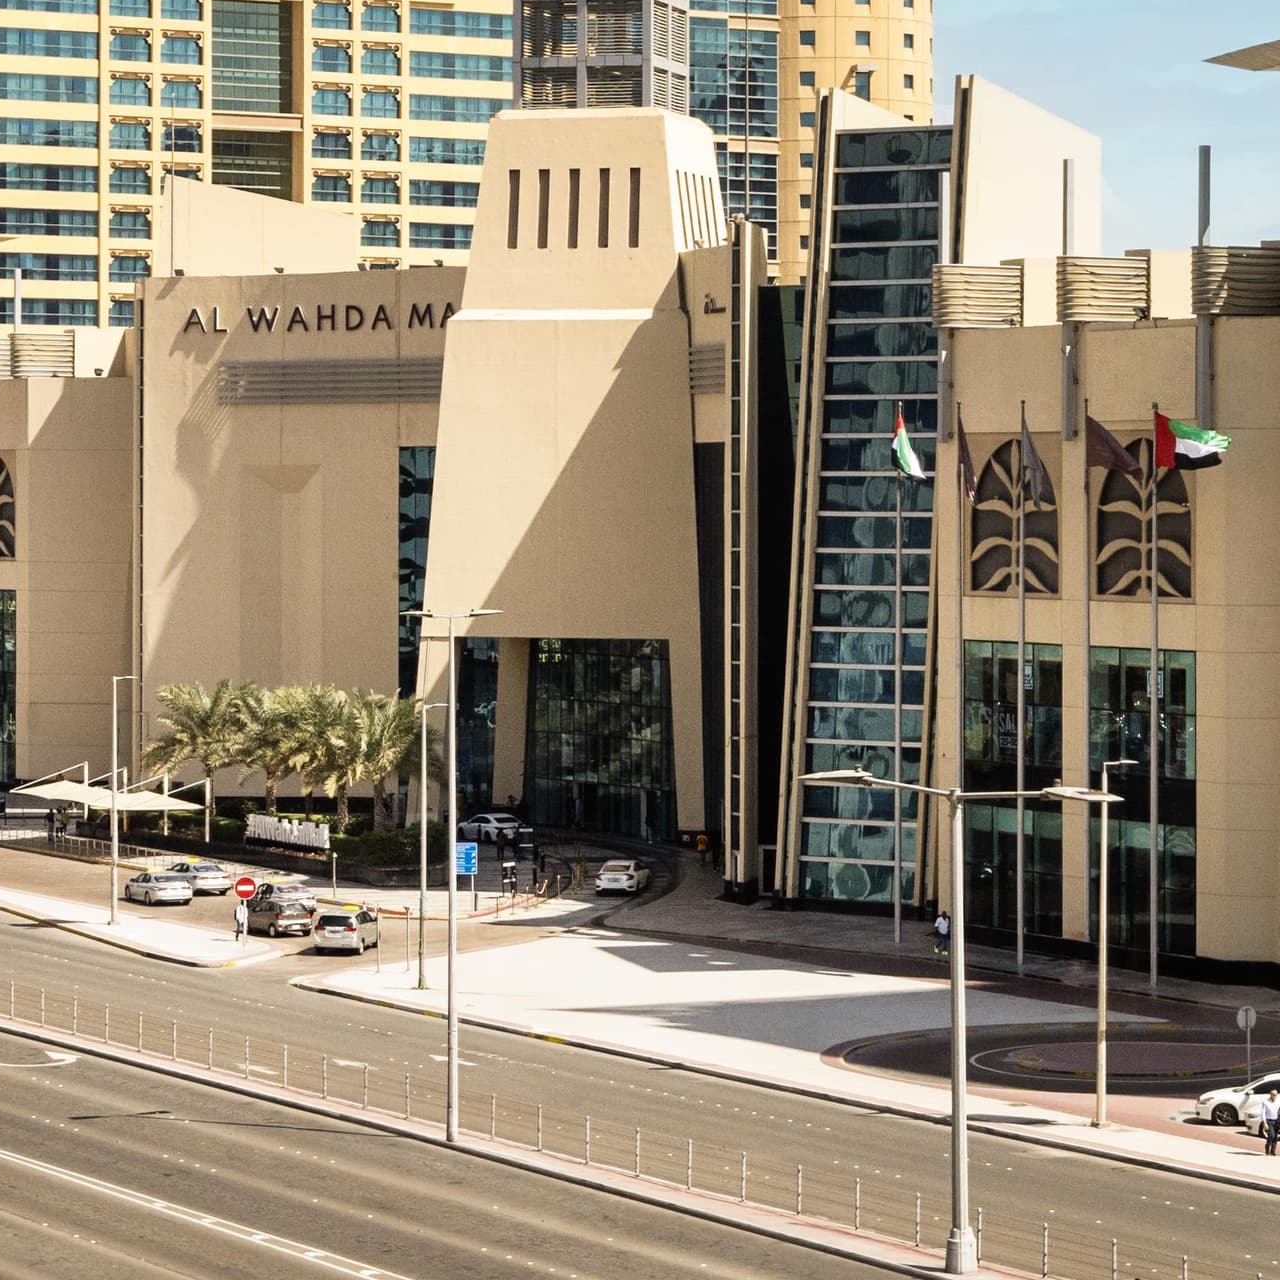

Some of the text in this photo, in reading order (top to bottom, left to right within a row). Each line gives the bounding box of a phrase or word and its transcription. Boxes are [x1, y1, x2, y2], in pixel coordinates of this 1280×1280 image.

[183, 301, 454, 333] AL WAHDA MA
